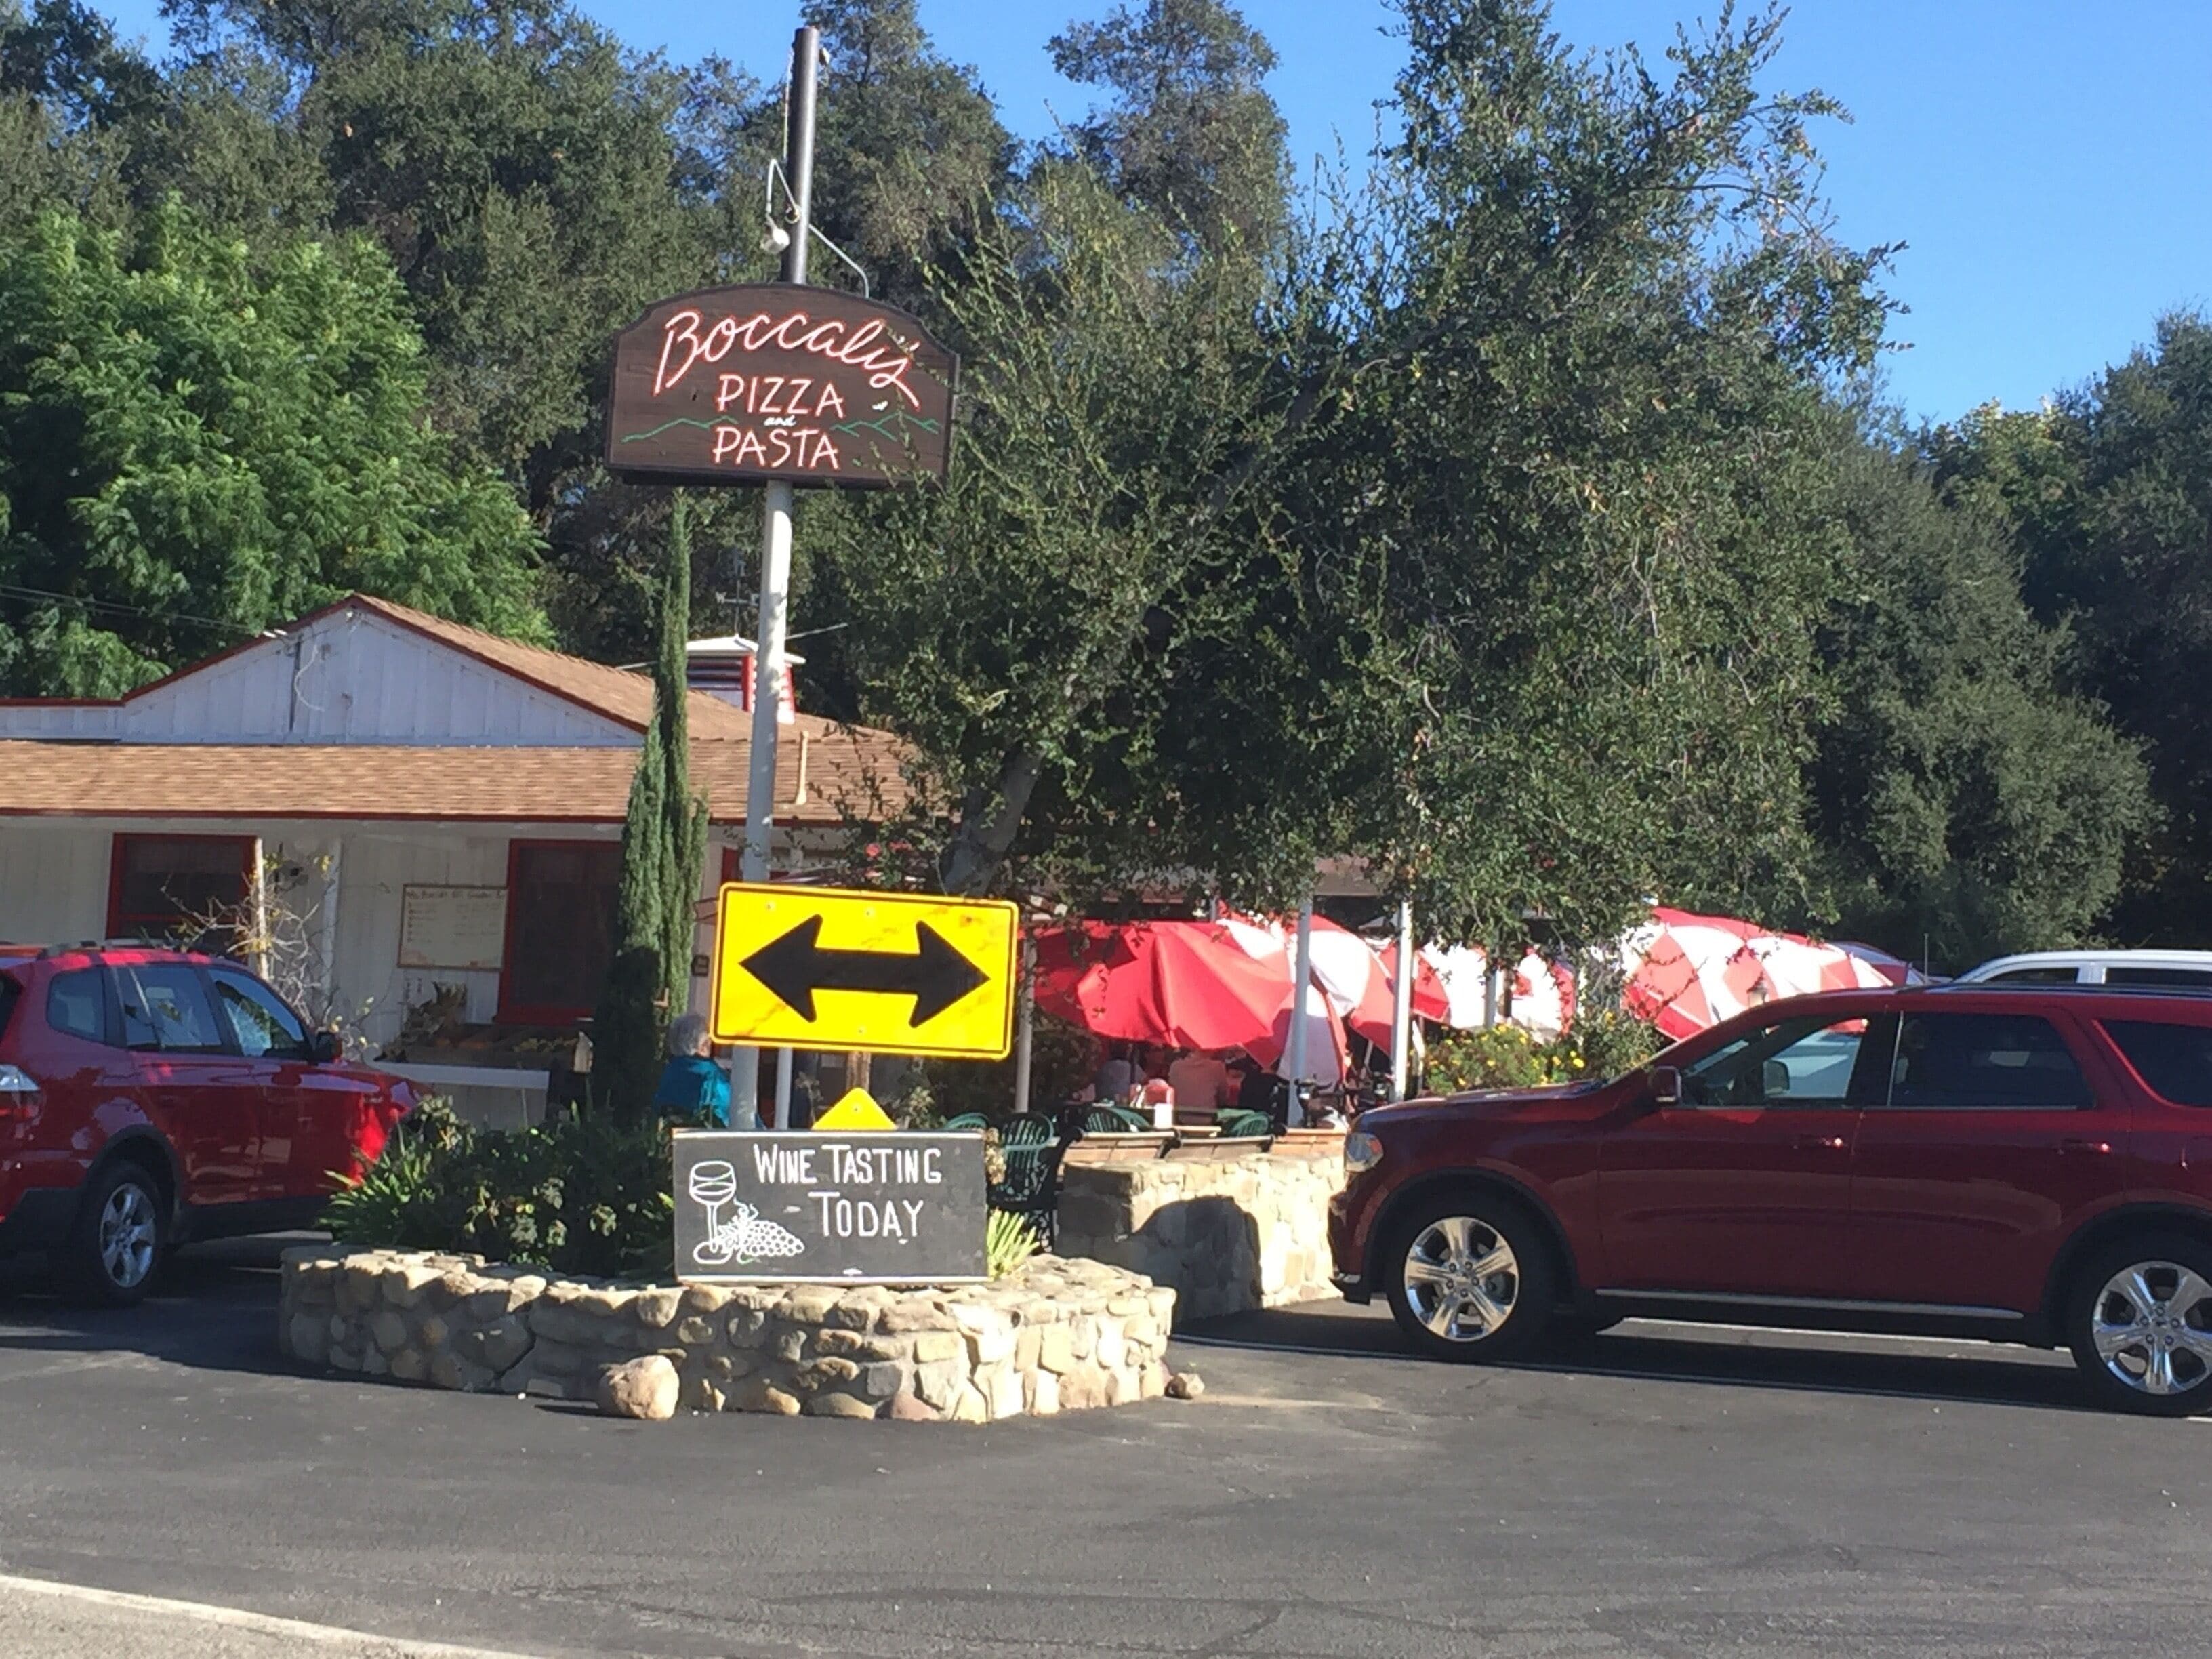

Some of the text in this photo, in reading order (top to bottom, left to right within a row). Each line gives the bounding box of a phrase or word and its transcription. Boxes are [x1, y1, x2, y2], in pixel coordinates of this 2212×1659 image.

[716, 373, 844, 419] PIZZA
[763, 414, 797, 427] and
[711, 426, 840, 471] PASTA
